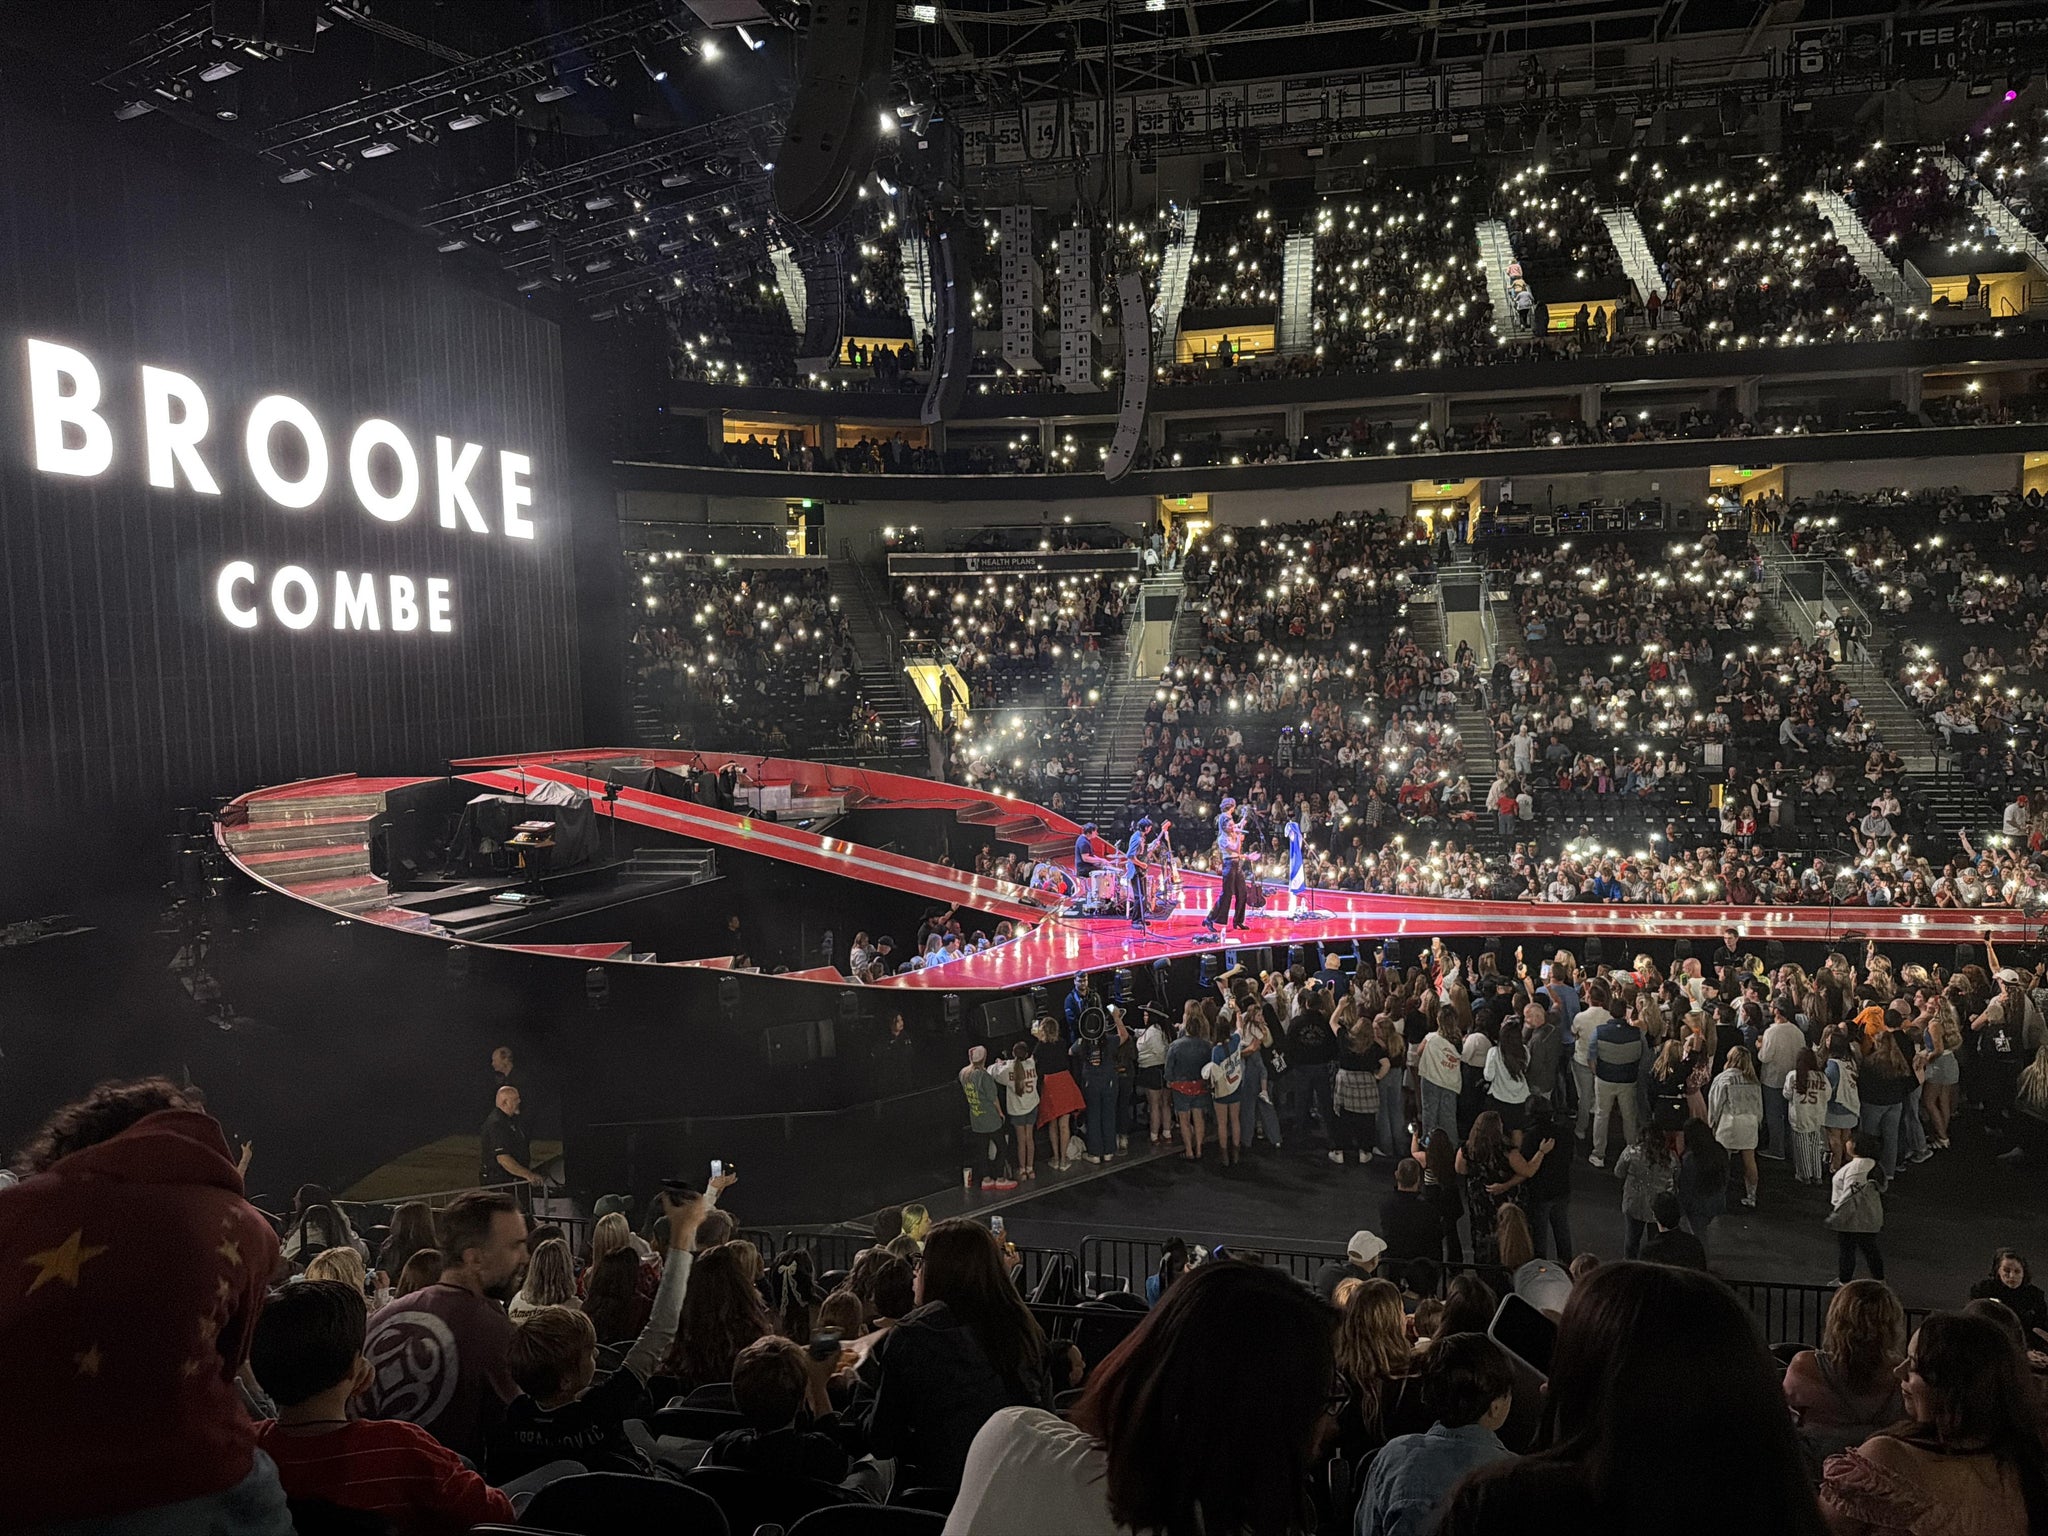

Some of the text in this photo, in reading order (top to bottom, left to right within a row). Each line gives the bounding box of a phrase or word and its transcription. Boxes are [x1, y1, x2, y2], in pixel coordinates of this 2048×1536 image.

[1900, 26, 1955, 47] TEE
[1000, 128, 1021, 144] 53
[1037, 125, 1053, 141] 14
[27, 338, 536, 541] BROOKE
[982, 558, 1036, 566] HEALTH PLANS
[216, 560, 453, 634] COMBE
[1799, 1091, 1818, 1104] 25
